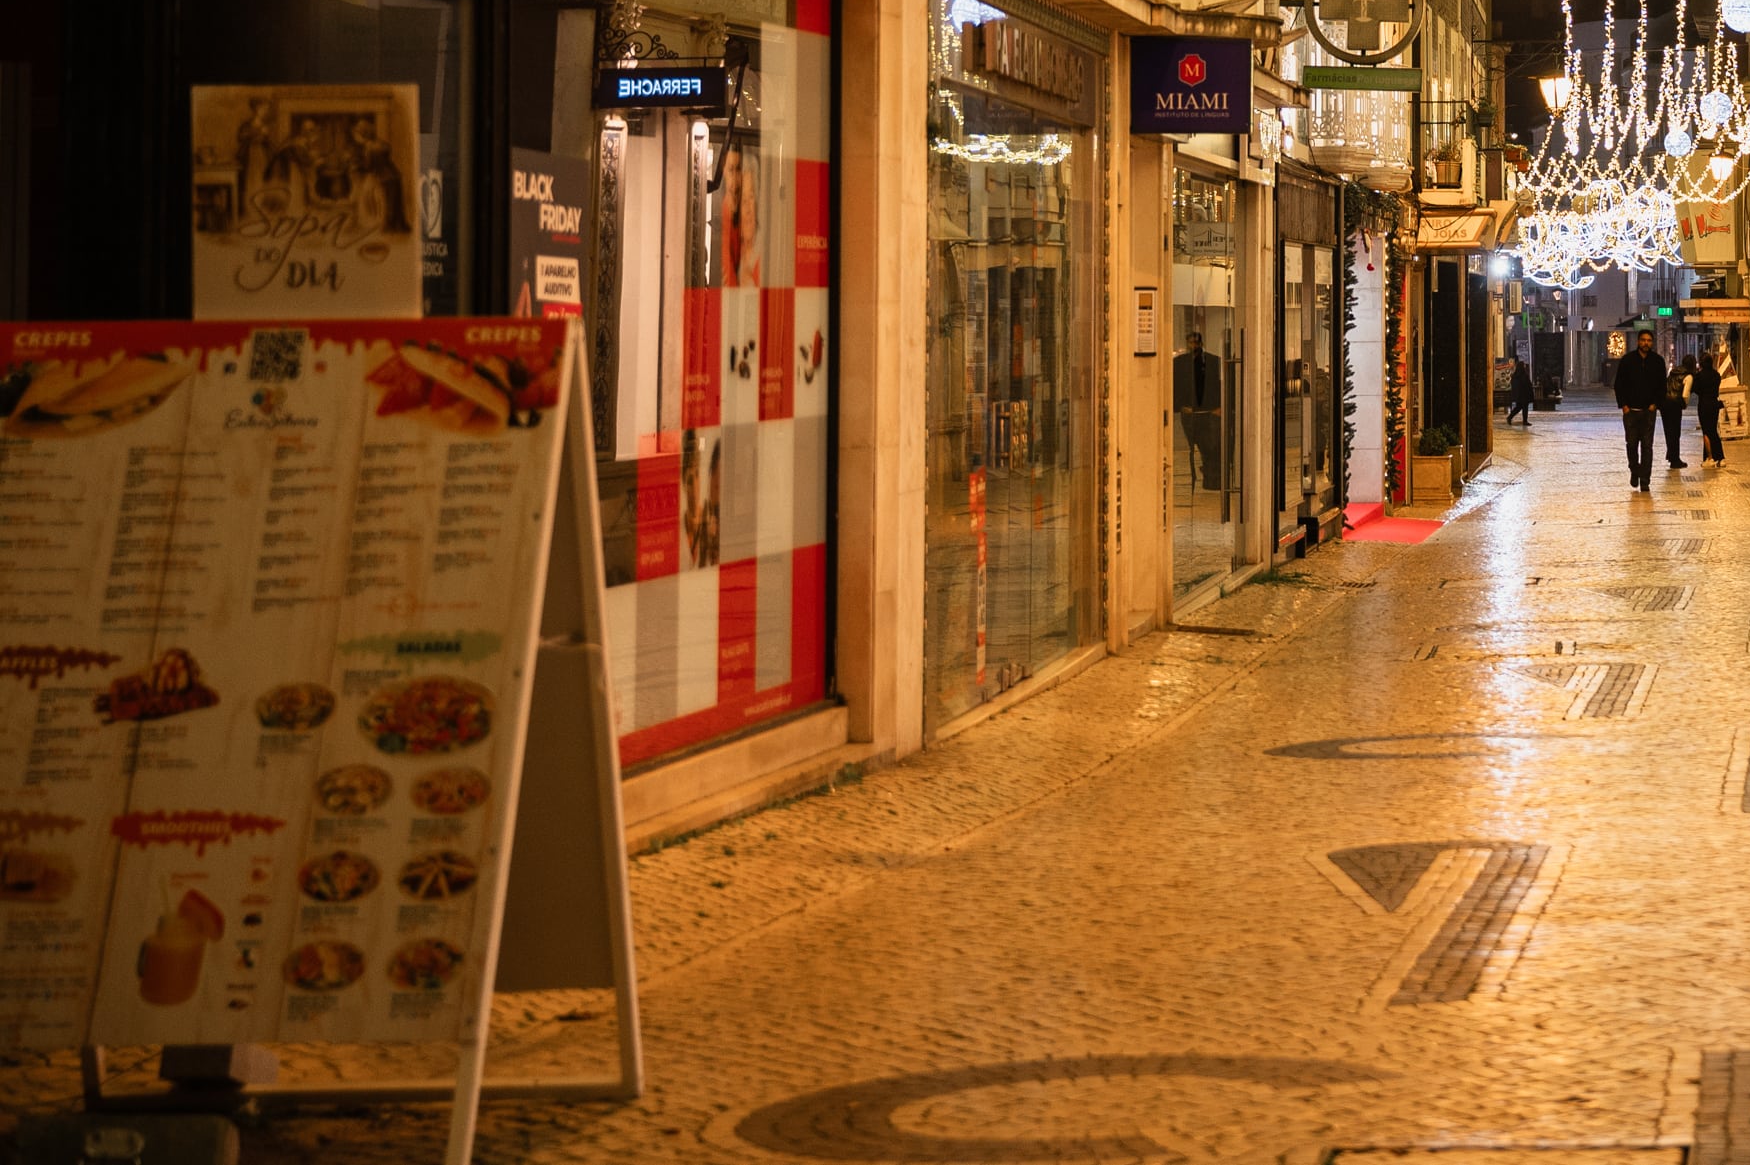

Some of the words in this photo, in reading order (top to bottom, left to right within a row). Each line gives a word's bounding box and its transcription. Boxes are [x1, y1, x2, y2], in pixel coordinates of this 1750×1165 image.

[1184, 63, 1200, 77] M
[1305, 73, 1357, 83] Farmácias
[1156, 93, 1229, 110] MIAMI
[513, 169, 554, 202] BLACK
[539, 204, 582, 234] FRIDAY
[544, 264, 577, 280] APARELHO
[544, 282, 573, 297] AUDITIVO
[14, 330, 92, 349] CREPES
[464, 325, 543, 345] CREPES
